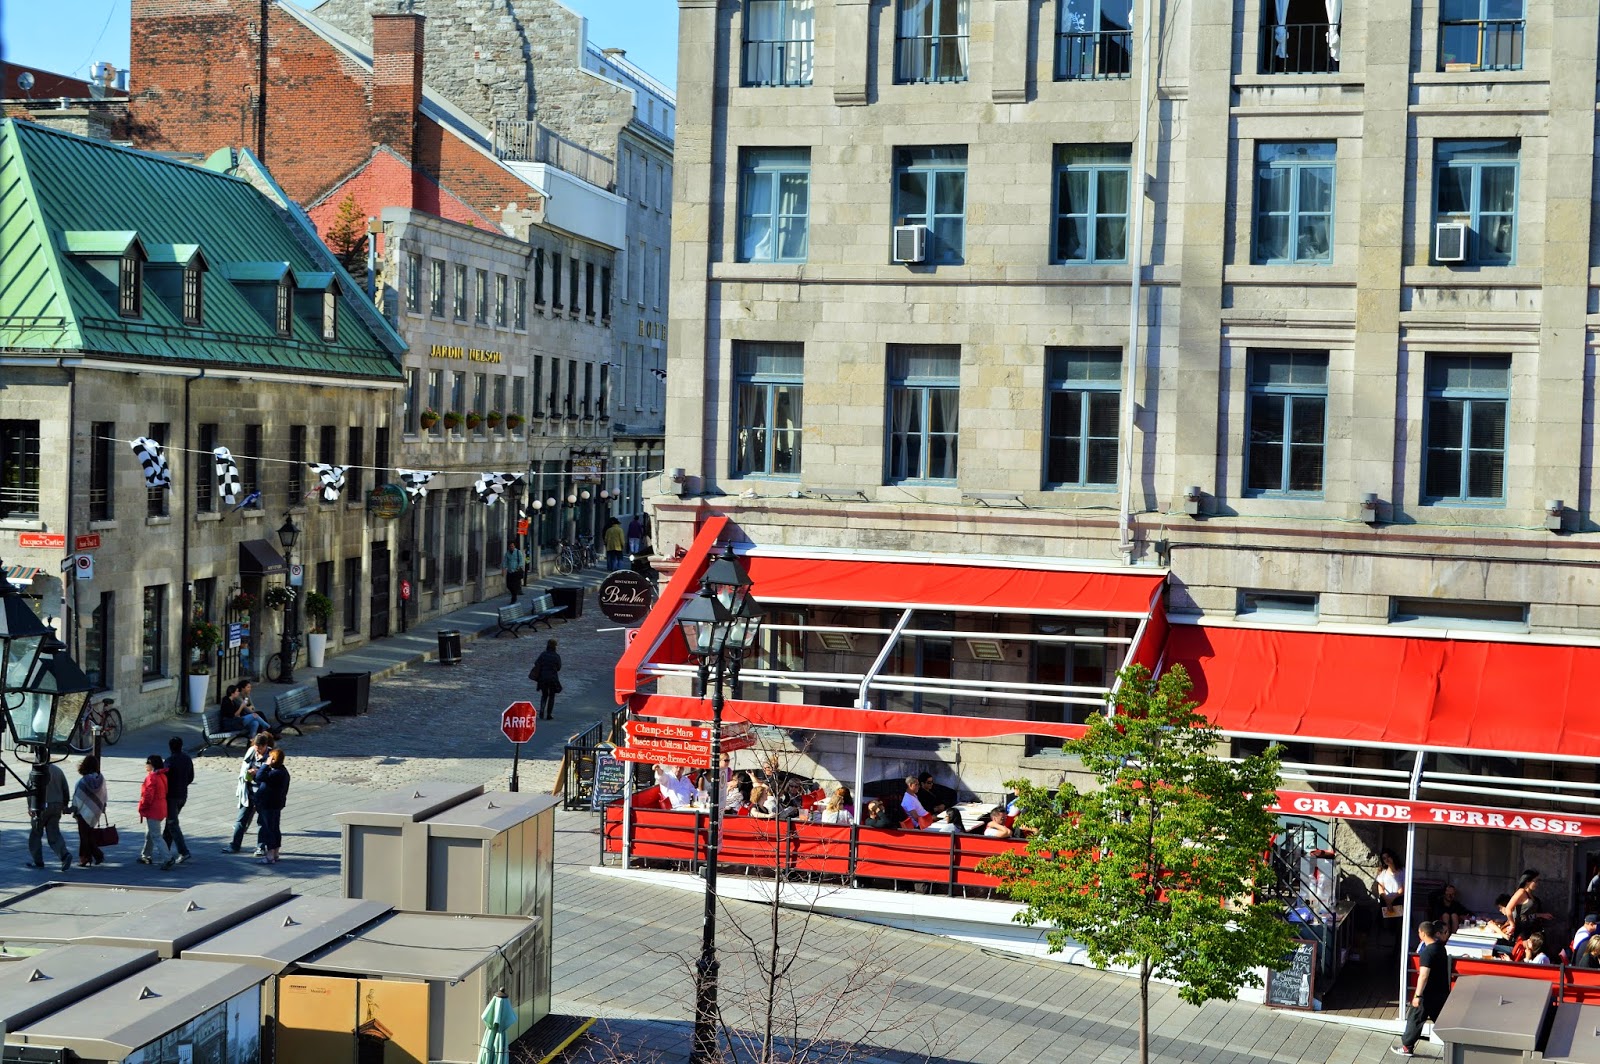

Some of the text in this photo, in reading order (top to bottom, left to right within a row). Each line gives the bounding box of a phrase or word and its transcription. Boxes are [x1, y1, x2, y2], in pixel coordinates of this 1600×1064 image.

[430, 344, 503, 363] JARDIN NELSON
[21, 538, 65, 546] Jacques-Cartier
[601, 585, 648, 603] Bella Vita
[635, 723, 694, 738] Champ-de-Mars
[632, 736, 650, 746] Musée
[651, 739, 659, 747] du
[660, 739, 682, 750] Château
[618, 749, 636, 758] Maison
[1294, 797, 1411, 819] GRANDE
[1429, 807, 1583, 835] TERRASSE
